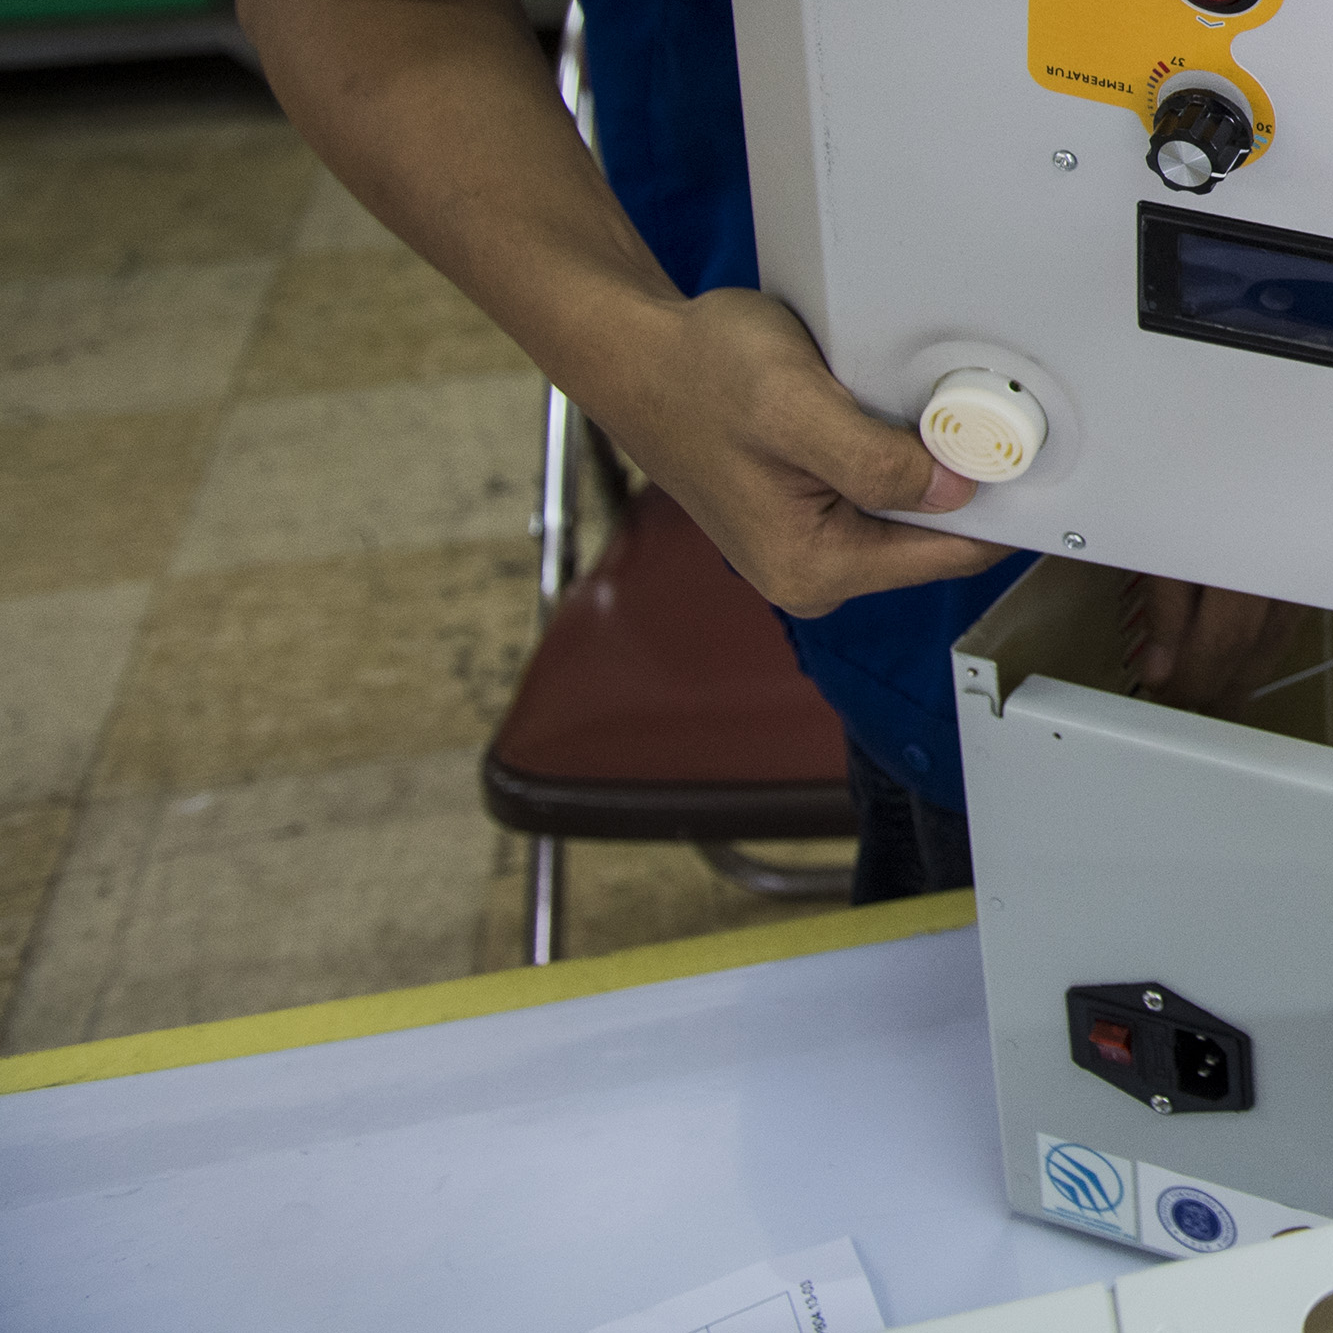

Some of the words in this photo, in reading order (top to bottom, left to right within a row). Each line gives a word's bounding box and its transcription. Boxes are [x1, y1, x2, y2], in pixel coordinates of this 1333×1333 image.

[1170, 55, 1186, 68] 37
[1044, 64, 1135, 95] TEMPERATUR
[1255, 121, 1273, 134] 30
